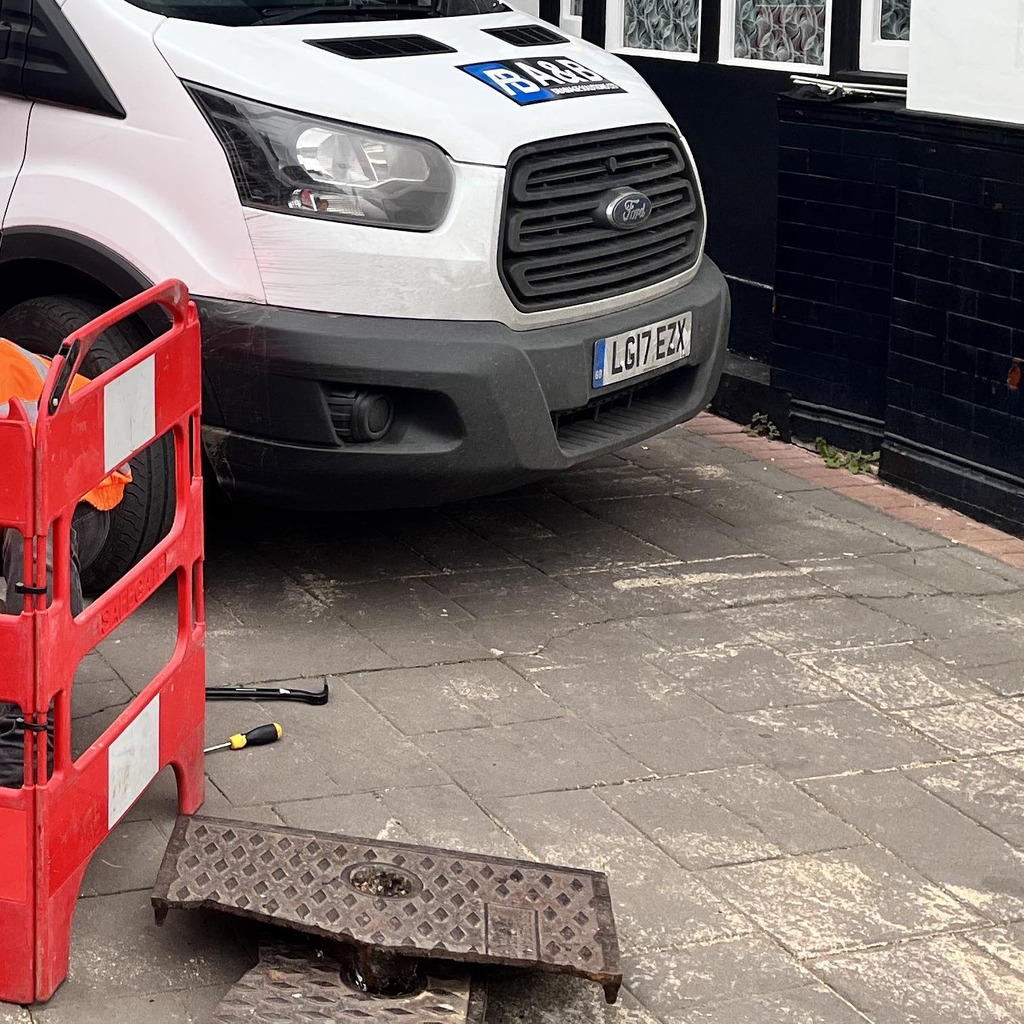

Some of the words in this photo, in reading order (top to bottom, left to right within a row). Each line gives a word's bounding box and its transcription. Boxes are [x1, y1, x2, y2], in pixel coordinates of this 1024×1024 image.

[622, 199, 646, 222] Ford
[611, 330, 652, 375] LG17
[656, 318, 686, 361] EZX
